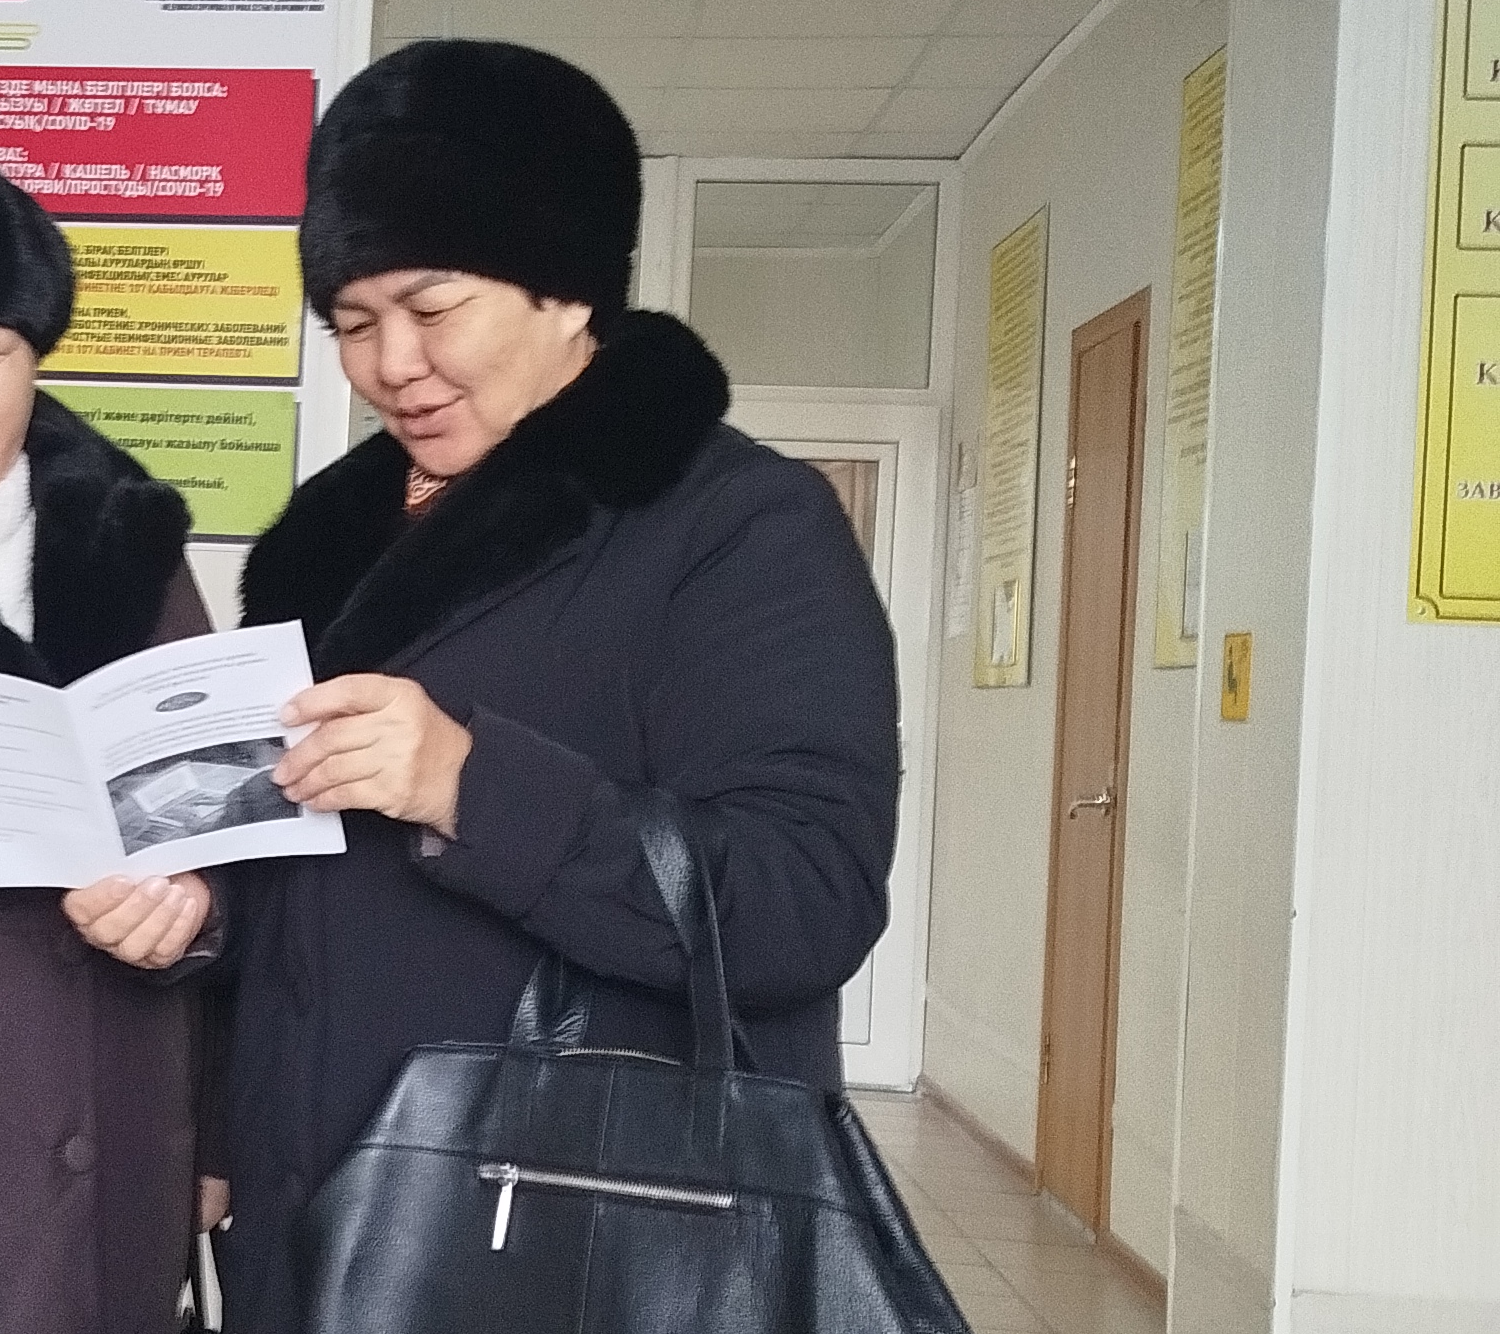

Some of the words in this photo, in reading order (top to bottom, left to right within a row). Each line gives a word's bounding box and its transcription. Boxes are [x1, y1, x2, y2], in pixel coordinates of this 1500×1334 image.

[32, 80, 82, 95] МЫНА
[83, 80, 168, 96] БЕЛГІЛЕРІ
[169, 82, 229, 98] БОЛСА:
[61, 163, 131, 179] КАШЕЛЬ
[146, 165, 223, 181] НАСМОРК
